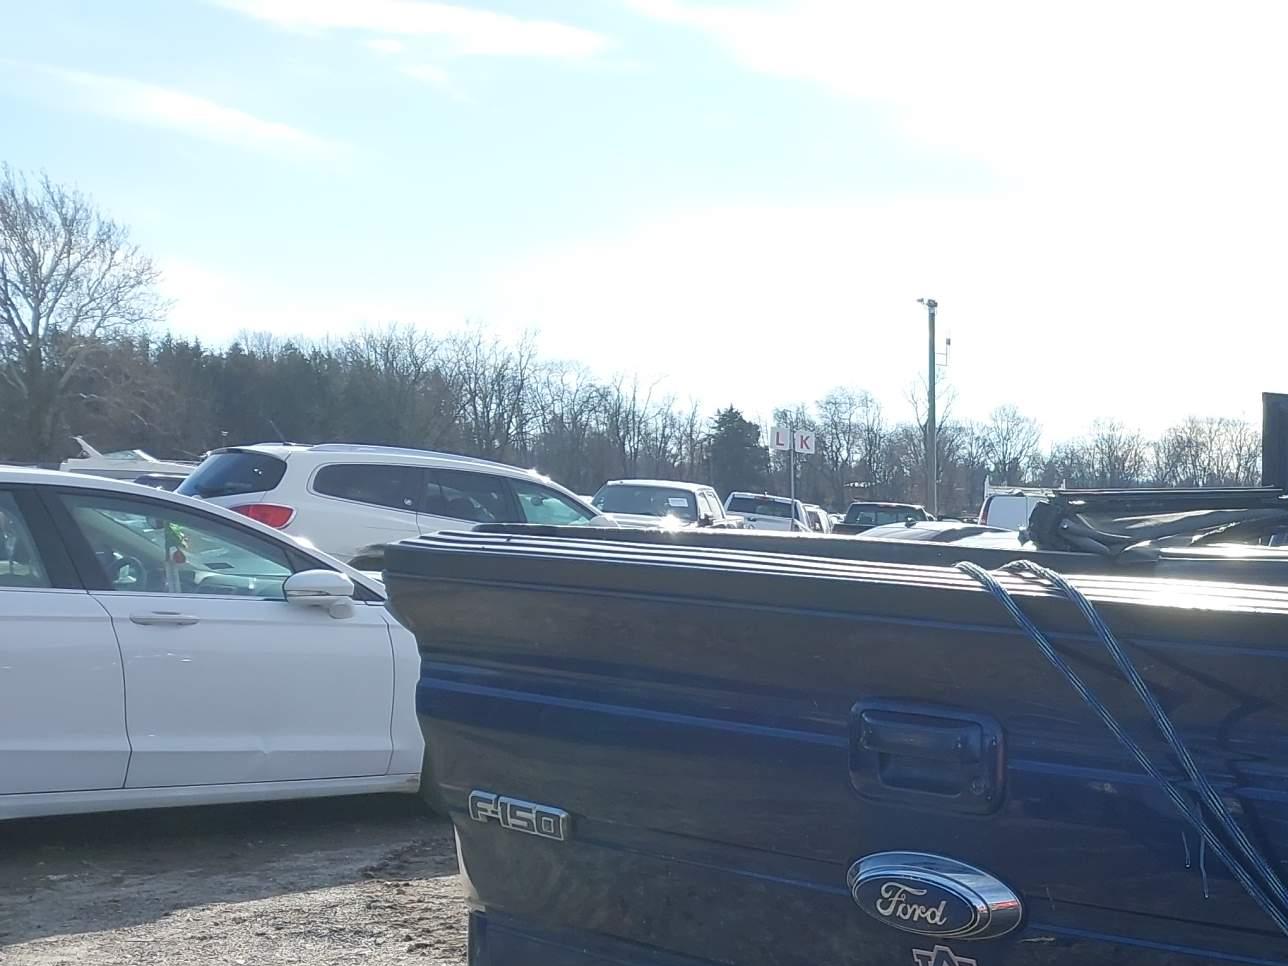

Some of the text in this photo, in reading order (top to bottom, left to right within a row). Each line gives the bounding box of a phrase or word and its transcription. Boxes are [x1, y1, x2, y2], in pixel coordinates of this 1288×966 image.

[776, 431, 785, 447] L
[800, 435, 811, 450] K
[468, 789, 568, 841] F-150
[876, 881, 948, 926] Ford
